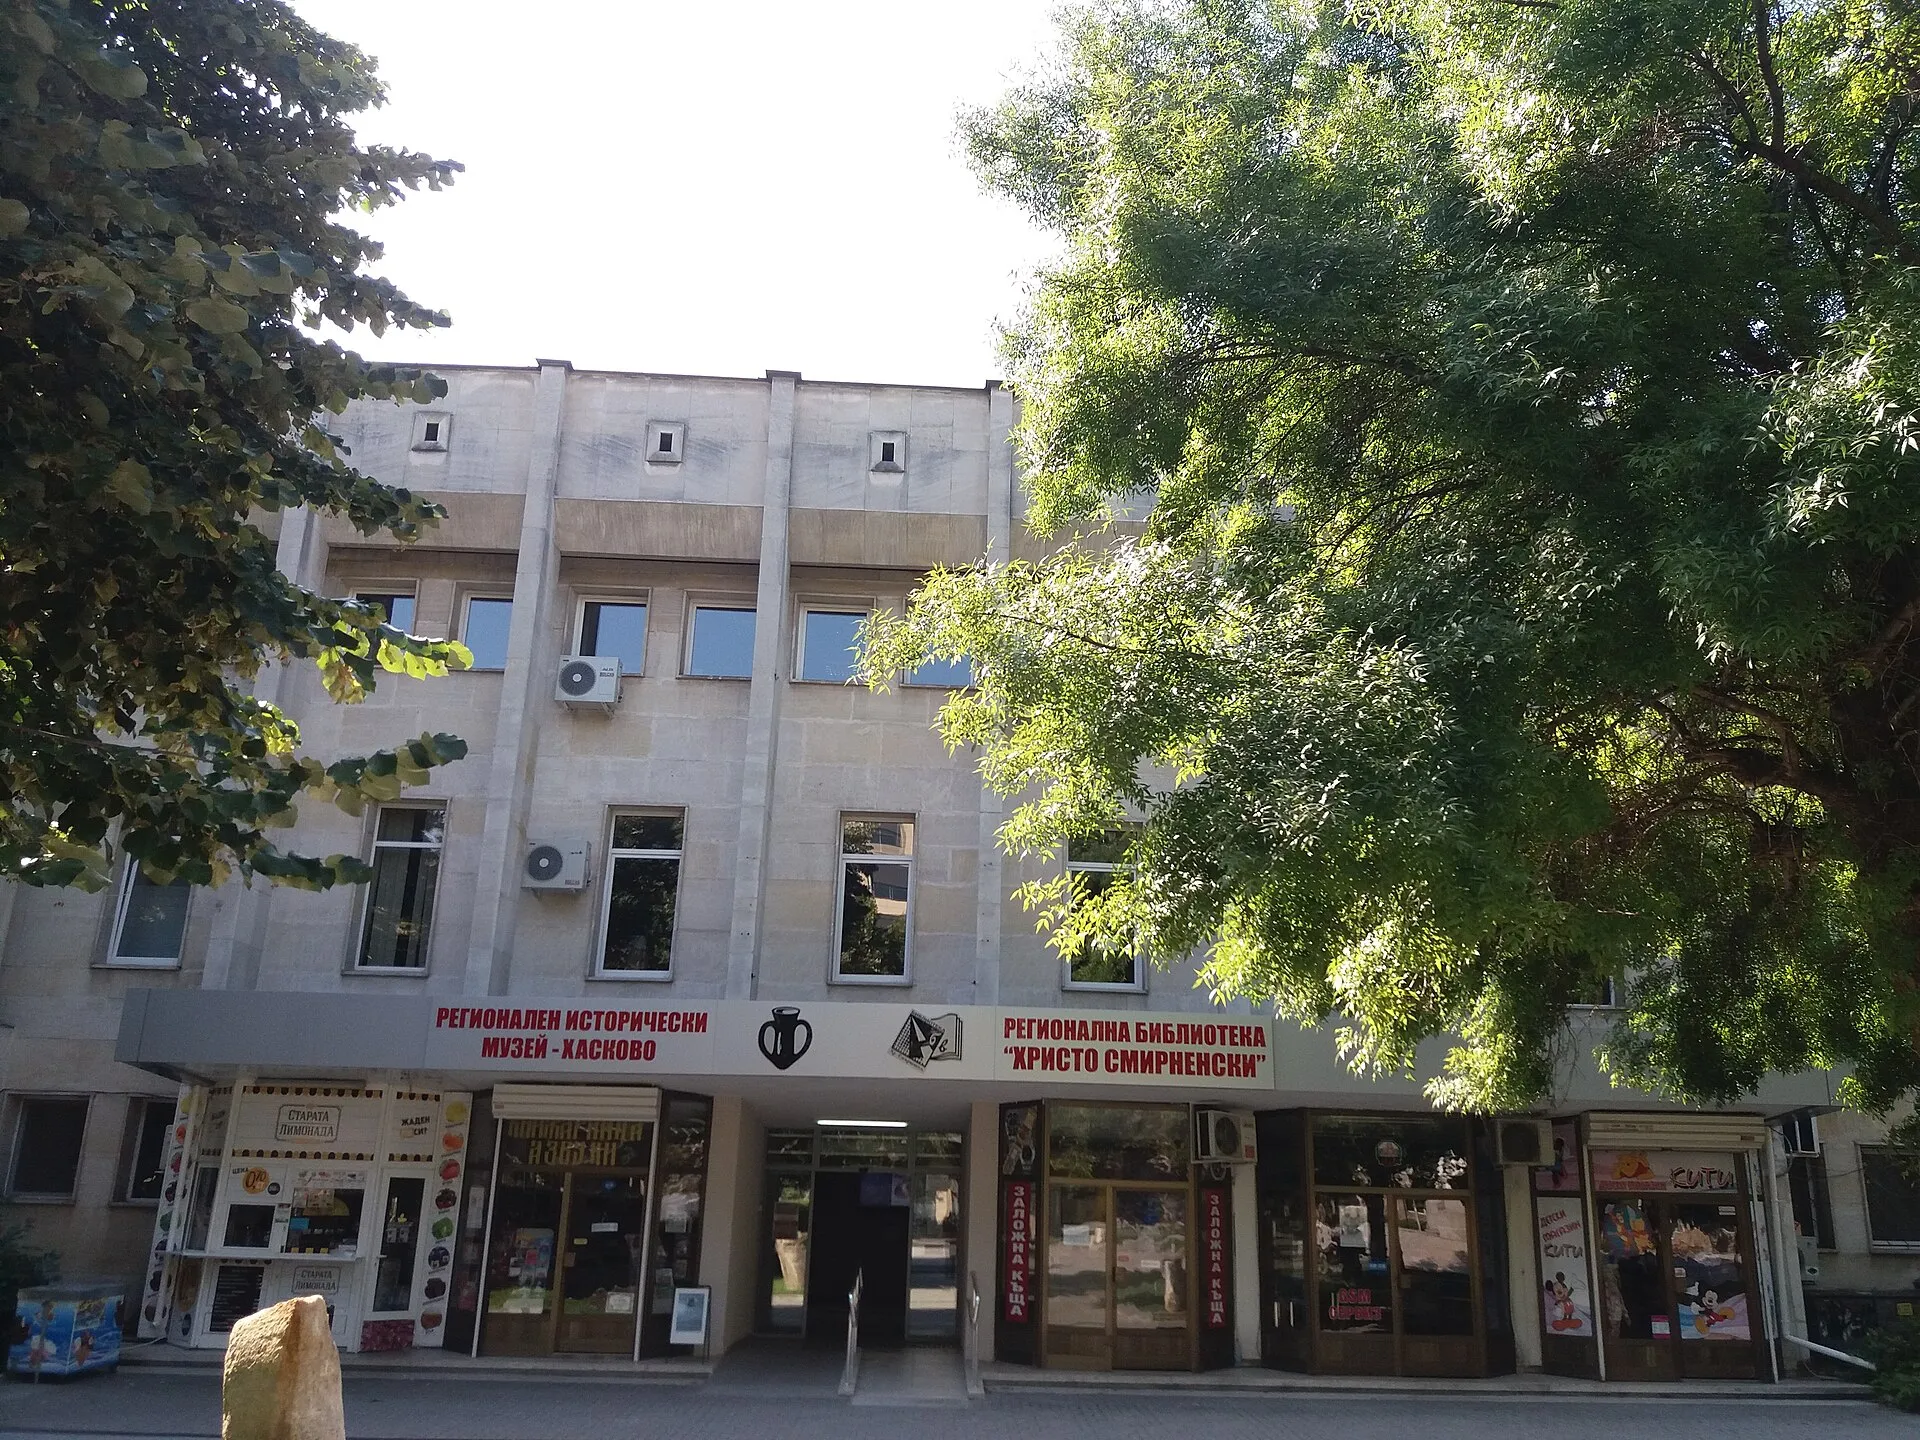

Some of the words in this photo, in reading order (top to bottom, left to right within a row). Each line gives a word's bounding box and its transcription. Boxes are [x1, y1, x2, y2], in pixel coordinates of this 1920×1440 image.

[436, 1007, 561, 1031] РЕГИОНАЛЕН
[565, 1010, 708, 1033] ИСТОРИЧЕСКИ
[1004, 1017, 1131, 1043] РЕГИОНАЛНА
[1135, 1021, 1266, 1048] БИБЛИОТЕКА
[481, 1034, 548, 1059] МУЗЕЙ
[562, 1039, 657, 1061] ХАСКОВО
[288, 1109, 329, 1122] СТАРАТА
[401, 1116, 430, 1126] ЖАДЕН
[278, 1124, 334, 1137] ЛИМОНАДА
[1010, 1185, 1026, 1265] ЗАЛОЖНА
[1210, 1194, 1222, 1272] ЗАЛОЖНА
[294, 1280, 336, 1291] ЛИМОНАДА
[301, 1270, 332, 1280] СТАРАТА
[1009, 1270, 1025, 1316] КЪЩА
[1210, 1278, 1224, 1323] КЪЩА
